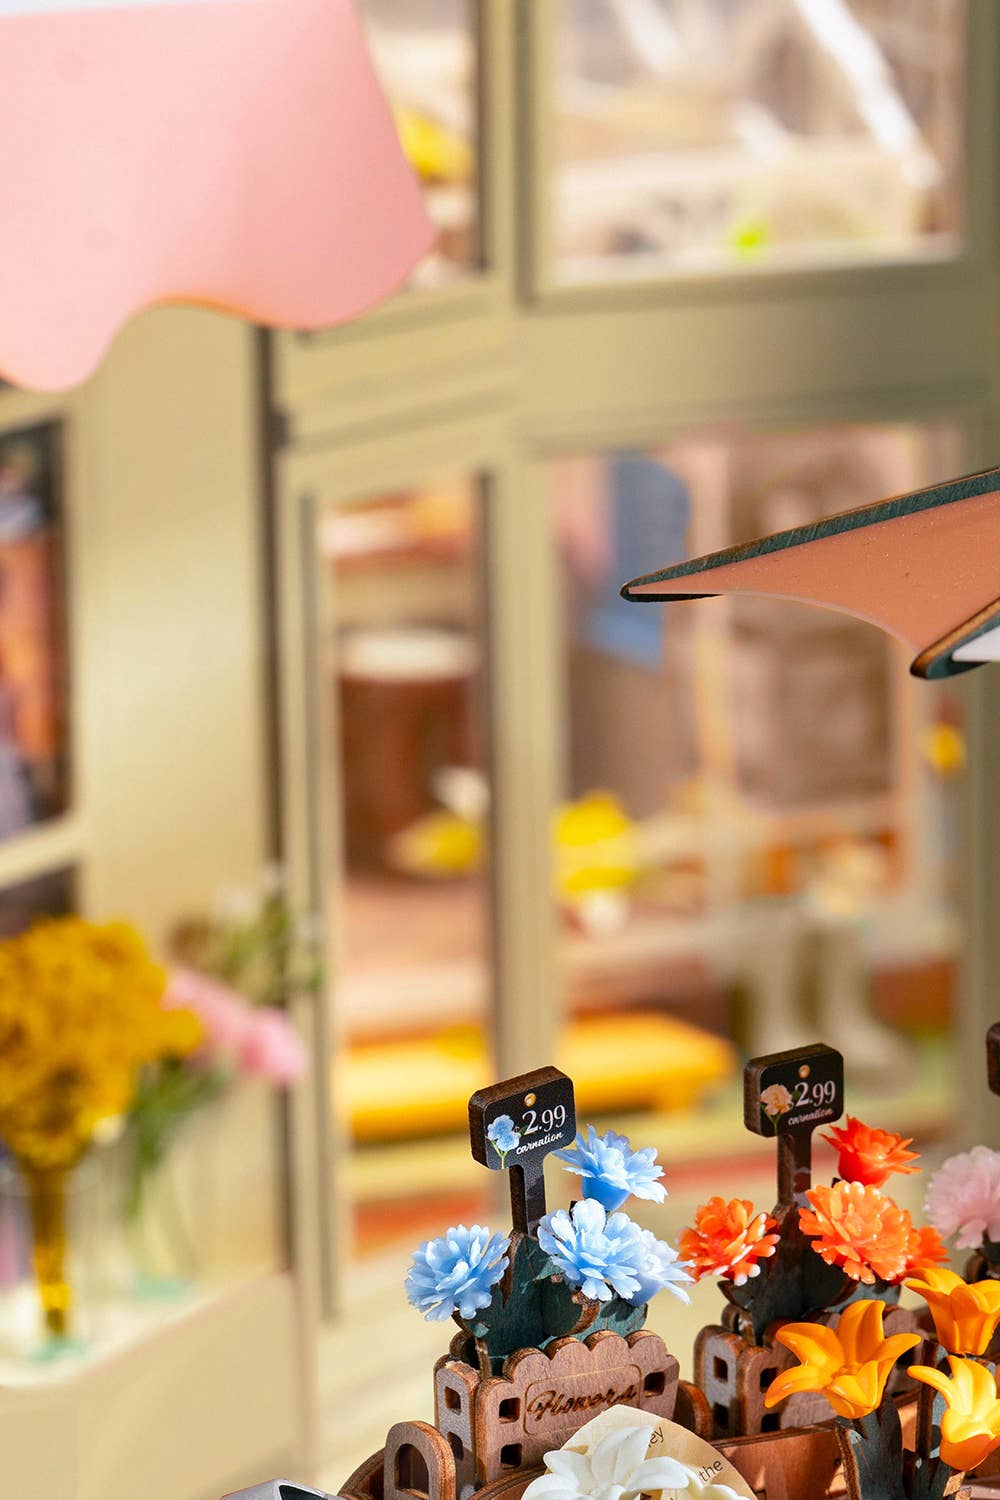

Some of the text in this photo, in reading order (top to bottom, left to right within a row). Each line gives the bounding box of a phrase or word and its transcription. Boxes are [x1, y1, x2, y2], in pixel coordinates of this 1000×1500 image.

[794, 1080, 836, 1107] 2.99
[522, 1104, 567, 1135] 2.99
[516, 1130, 563, 1155] carnation
[699, 1460, 723, 1482] the
